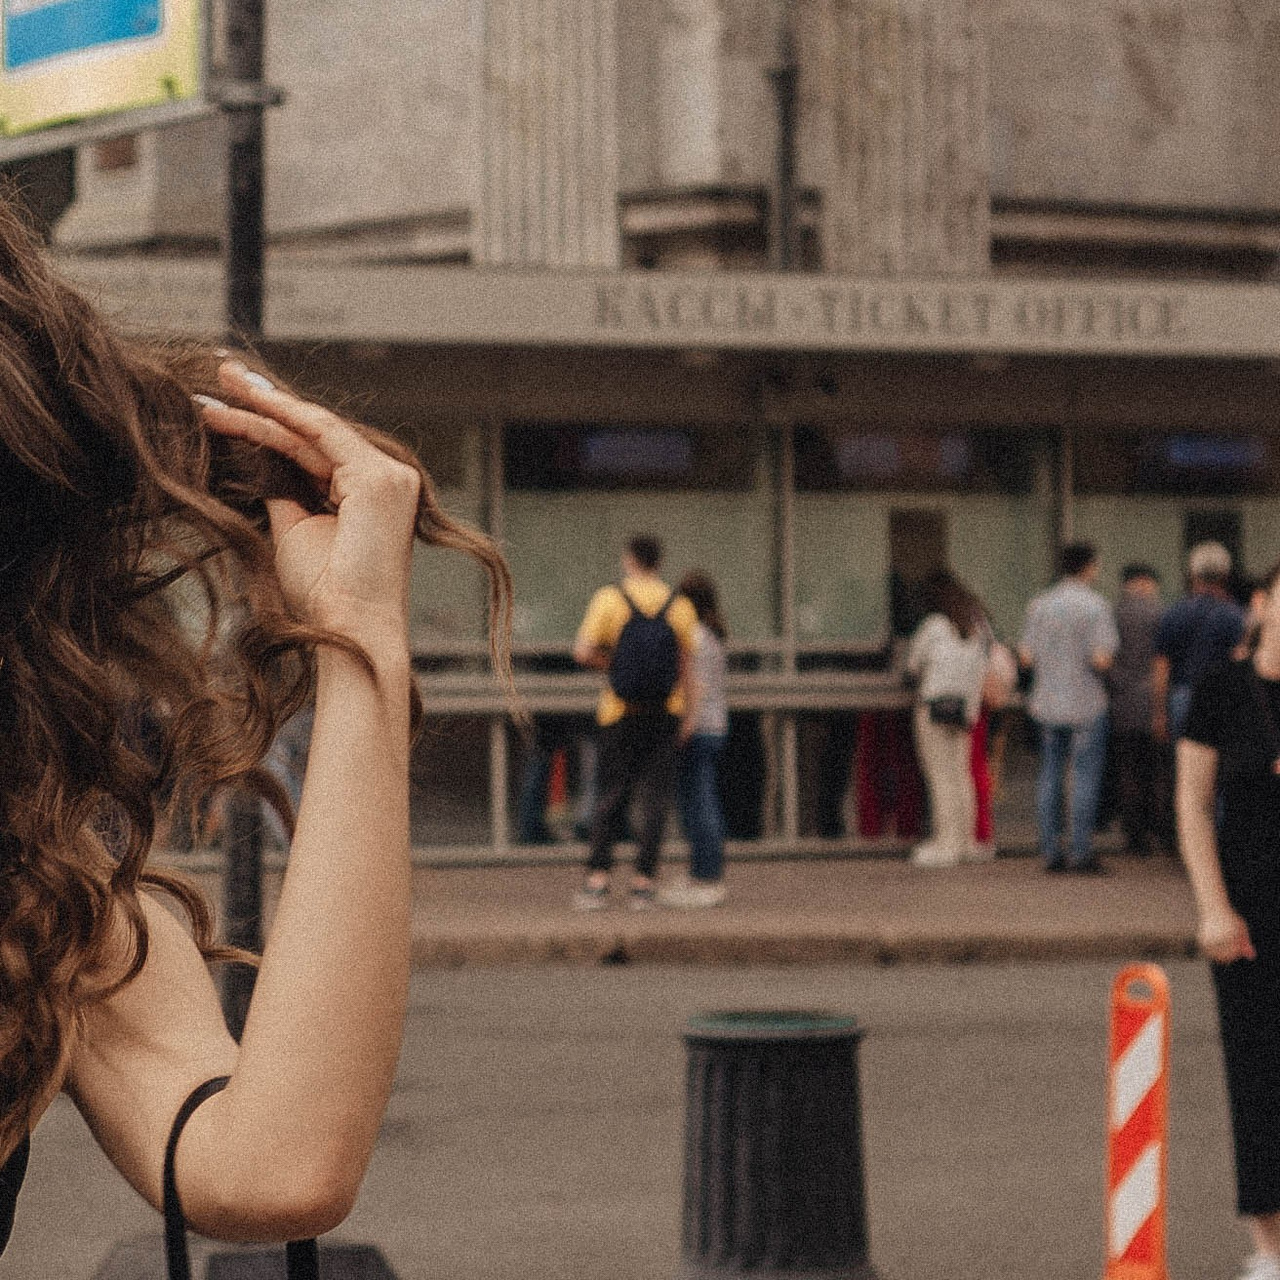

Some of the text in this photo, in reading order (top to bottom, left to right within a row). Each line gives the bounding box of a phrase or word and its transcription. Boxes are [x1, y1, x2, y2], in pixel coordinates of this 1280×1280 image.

[593, 284, 1188, 341] КАССЫ TICKET OFFICE
